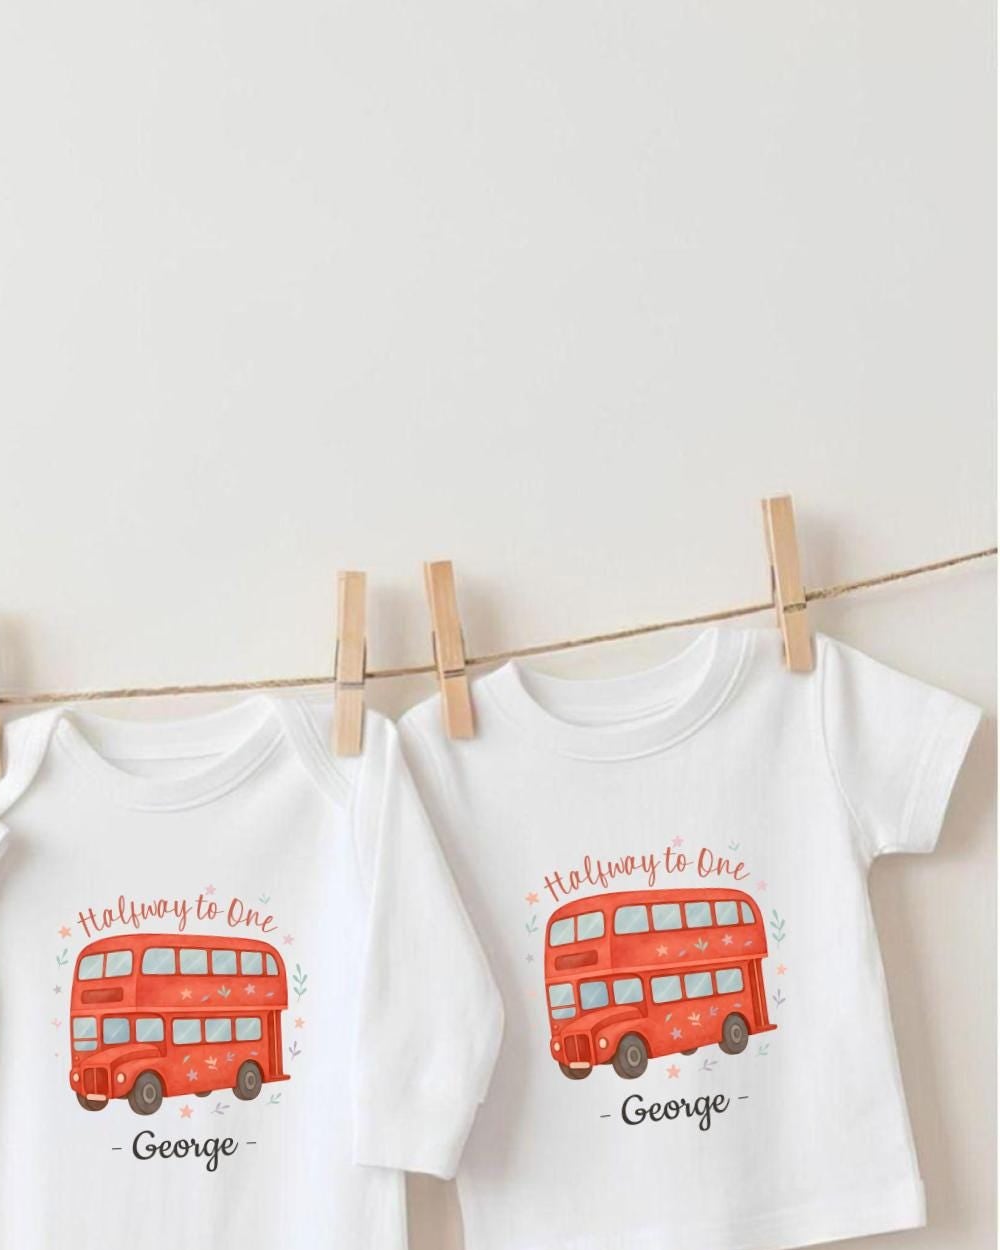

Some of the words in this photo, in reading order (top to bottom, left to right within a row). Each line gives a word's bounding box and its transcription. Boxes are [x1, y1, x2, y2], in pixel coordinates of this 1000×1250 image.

[543, 853, 661, 903] Halfway
[663, 846, 695, 874] to
[697, 847, 751, 881] One
[76, 894, 193, 938] Halfway
[195, 894, 225, 920] to
[227, 898, 279, 933] One
[621, 1094, 731, 1133] George
[132, 1130, 239, 1173] George
